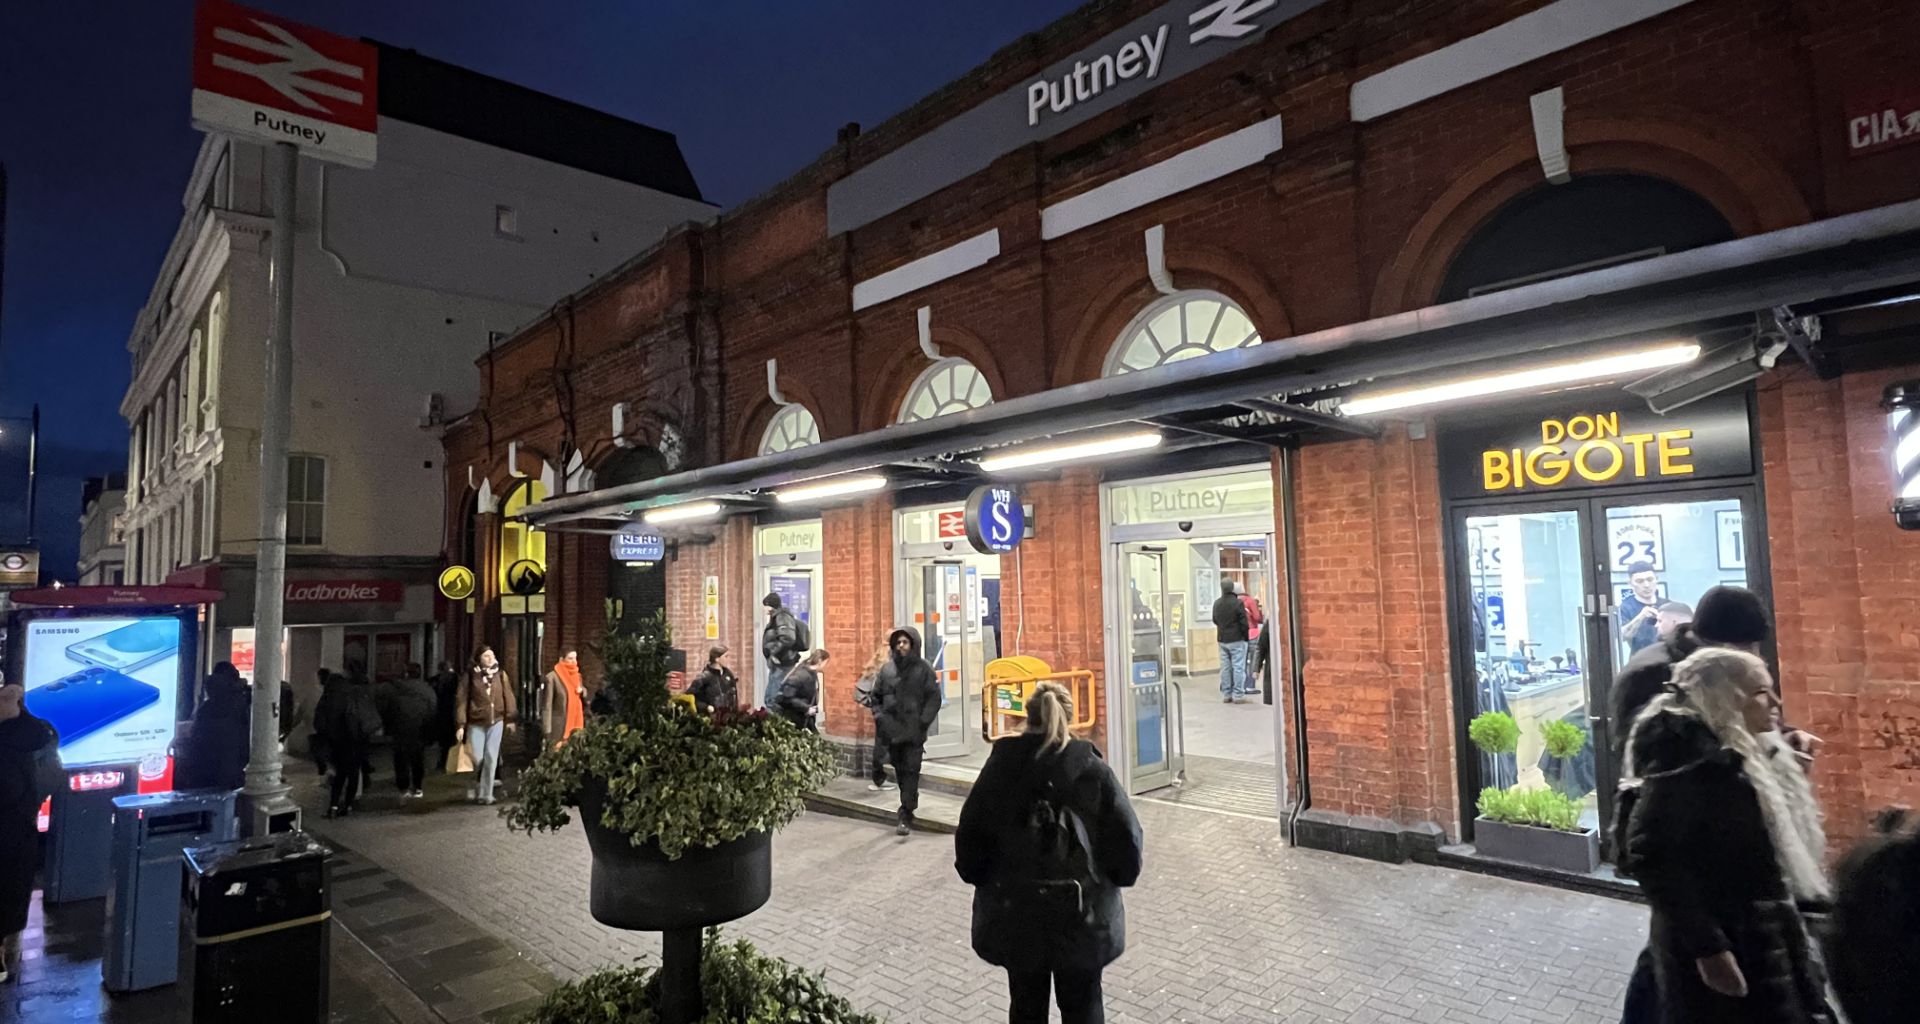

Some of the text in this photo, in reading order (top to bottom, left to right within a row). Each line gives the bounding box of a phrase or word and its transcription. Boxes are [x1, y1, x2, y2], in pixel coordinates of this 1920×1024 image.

[1028, 24, 1169, 126] Putney
[254, 111, 326, 145] Putney
[1541, 411, 1619, 444] DON
[1482, 429, 1694, 490] BIGOTE
[992, 488, 1010, 503] WH
[1150, 488, 1228, 513] Putney
[992, 501, 1011, 542] S
[620, 547, 659, 555] EXPRESS
[780, 532, 815, 548] Putney
[1617, 540, 1656, 565] 23
[285, 583, 380, 600] Ladbrokes
